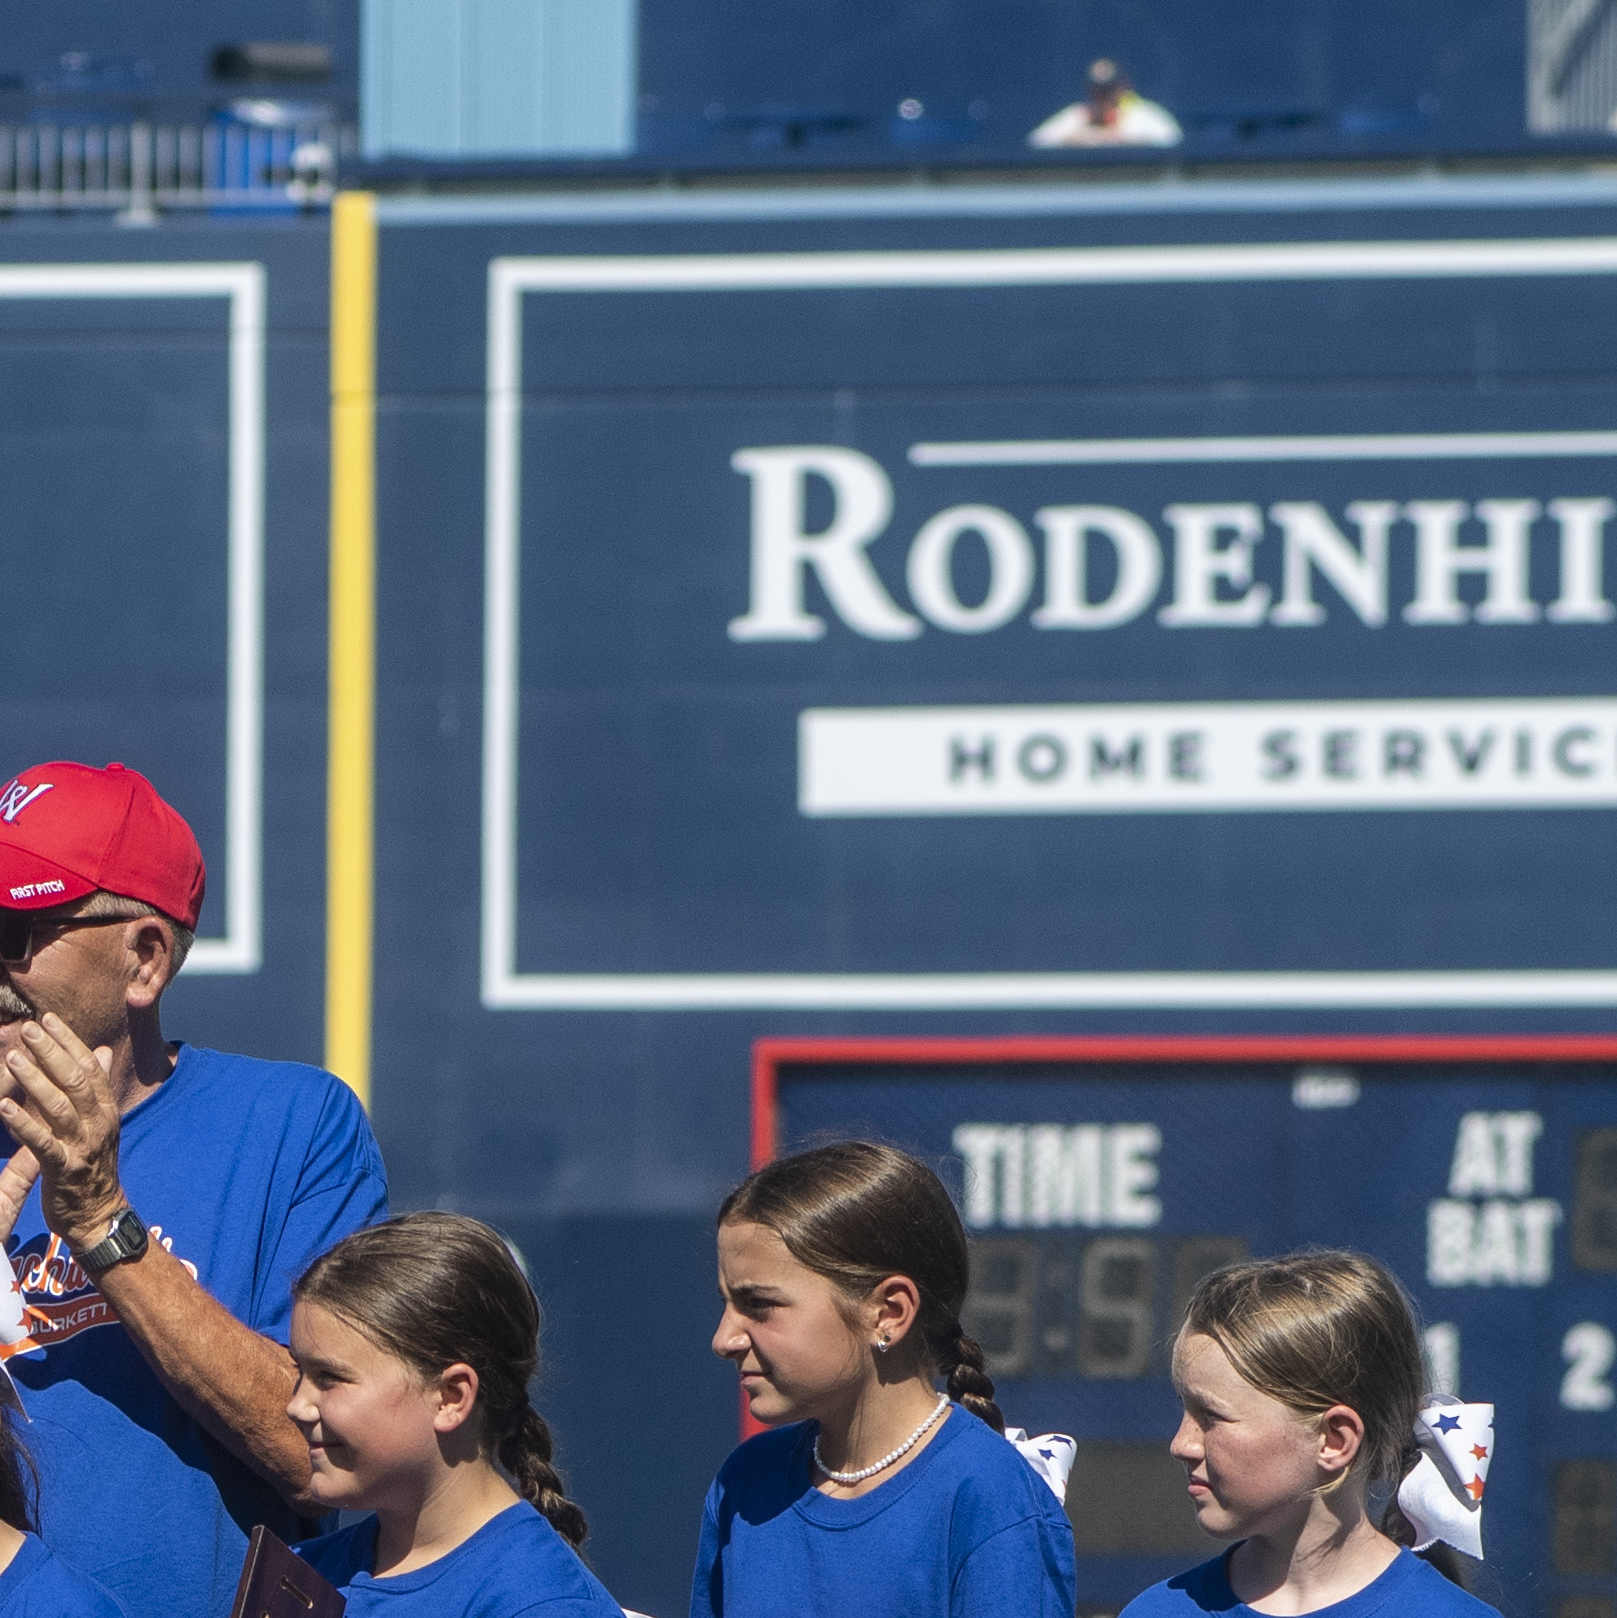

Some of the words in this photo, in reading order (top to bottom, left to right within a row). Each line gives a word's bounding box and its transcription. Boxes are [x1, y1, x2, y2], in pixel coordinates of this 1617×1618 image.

[727, 446, 1617, 641] RODENHI
[948, 730, 1207, 785] HOME
[1260, 724, 1617, 782] SERVIC
[36, 880, 65, 896] PITCH
[951, 1122, 1162, 1228] TIME
[1448, 1110, 1542, 1198] AT
[1425, 1200, 1559, 1287] BAT
[1560, 1322, 1615, 1410] 2
